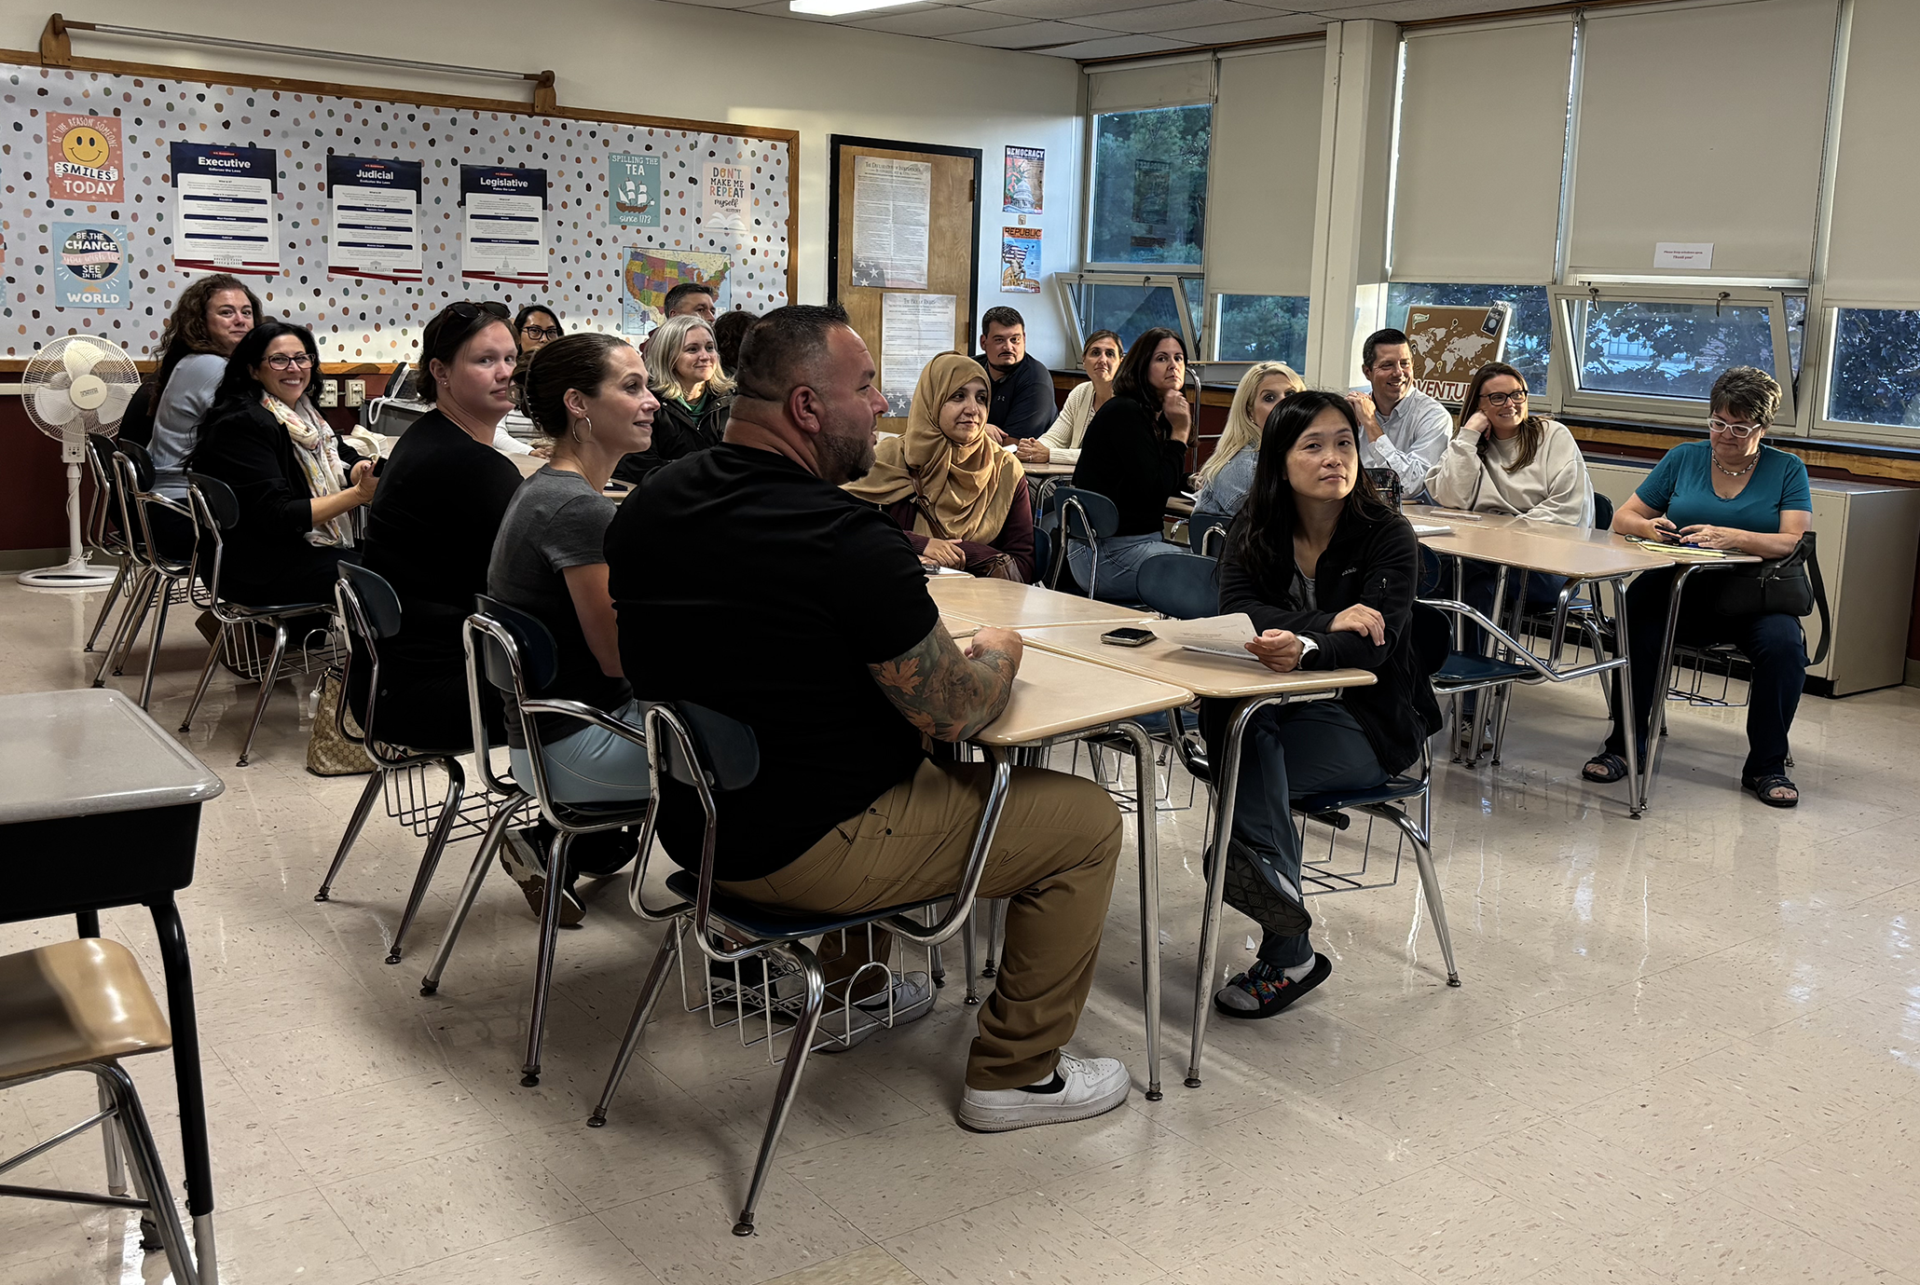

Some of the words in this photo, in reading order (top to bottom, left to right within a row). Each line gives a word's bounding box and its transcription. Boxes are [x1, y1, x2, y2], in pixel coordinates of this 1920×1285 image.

[67, 117, 94, 127] REASON
[95, 121, 118, 147] SOMEONE
[1006, 147, 1044, 158] DEMOCRACY
[198, 156, 251, 169] Executive
[612, 155, 643, 164] SPILLING
[645, 157, 659, 165] THE
[62, 163, 112, 181] SMILES
[356, 169, 394, 180] Judicial
[625, 164, 645, 176] TEA
[713, 167, 742, 179] DON'T
[63, 180, 116, 195] TODAY
[480, 177, 529, 188] Legislative
[710, 178, 732, 187] MAKE
[733, 180, 744, 188] ME
[709, 185, 745, 199] REPEAT
[714, 198, 739, 208] myself
[619, 215, 638, 223] since
[639, 214, 652, 224] 1773
[76, 232, 87, 240] BE
[1004, 227, 1042, 237] REPUBLIC
[65, 240, 117, 251] CHANGE
[82, 265, 101, 274] SEE
[67, 293, 120, 304] WORLD
